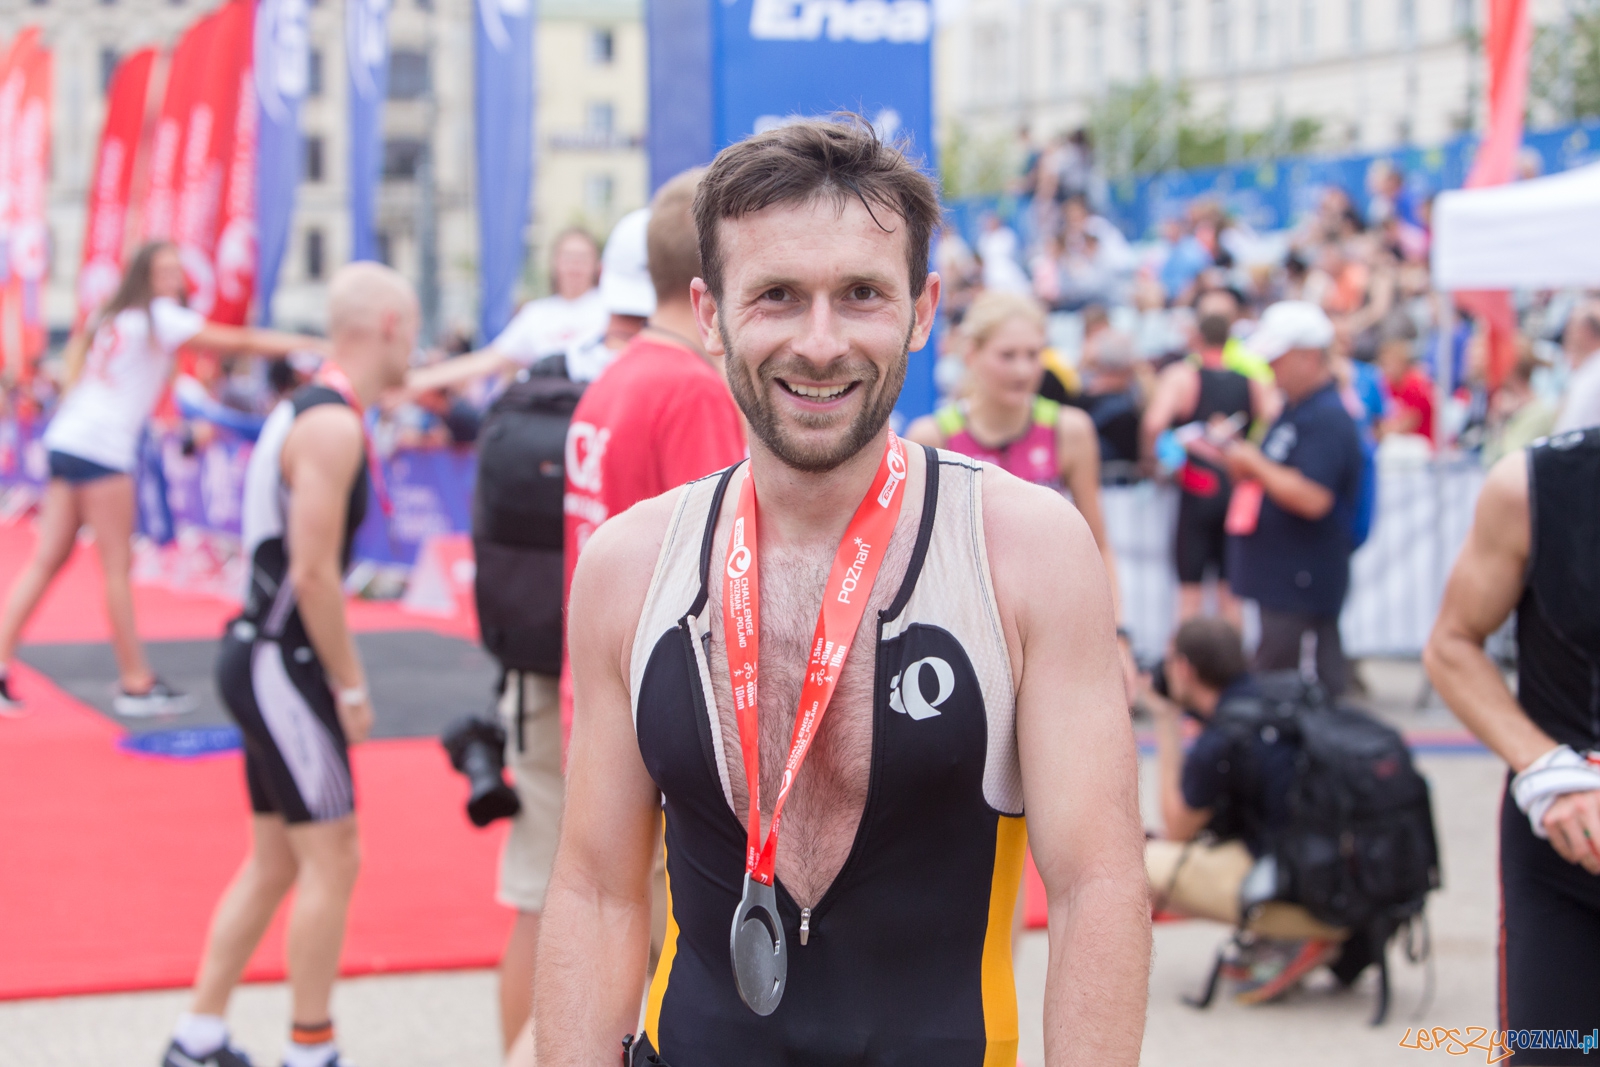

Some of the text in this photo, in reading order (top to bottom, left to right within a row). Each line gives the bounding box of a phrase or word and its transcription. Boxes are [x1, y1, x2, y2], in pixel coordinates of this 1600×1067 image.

[749, 0, 928, 43] Enea
[740, 577, 754, 636] CHALLENGE
[736, 616, 747, 648] POLAND
[811, 637, 824, 665] 1.5km
[820, 641, 834, 666] 40km
[829, 645, 847, 668] 10km
[734, 684, 745, 711] 10km
[746, 681, 754, 707] 40km
[805, 701, 819, 733] POLAND
[786, 709, 811, 768] CHALLENGE
